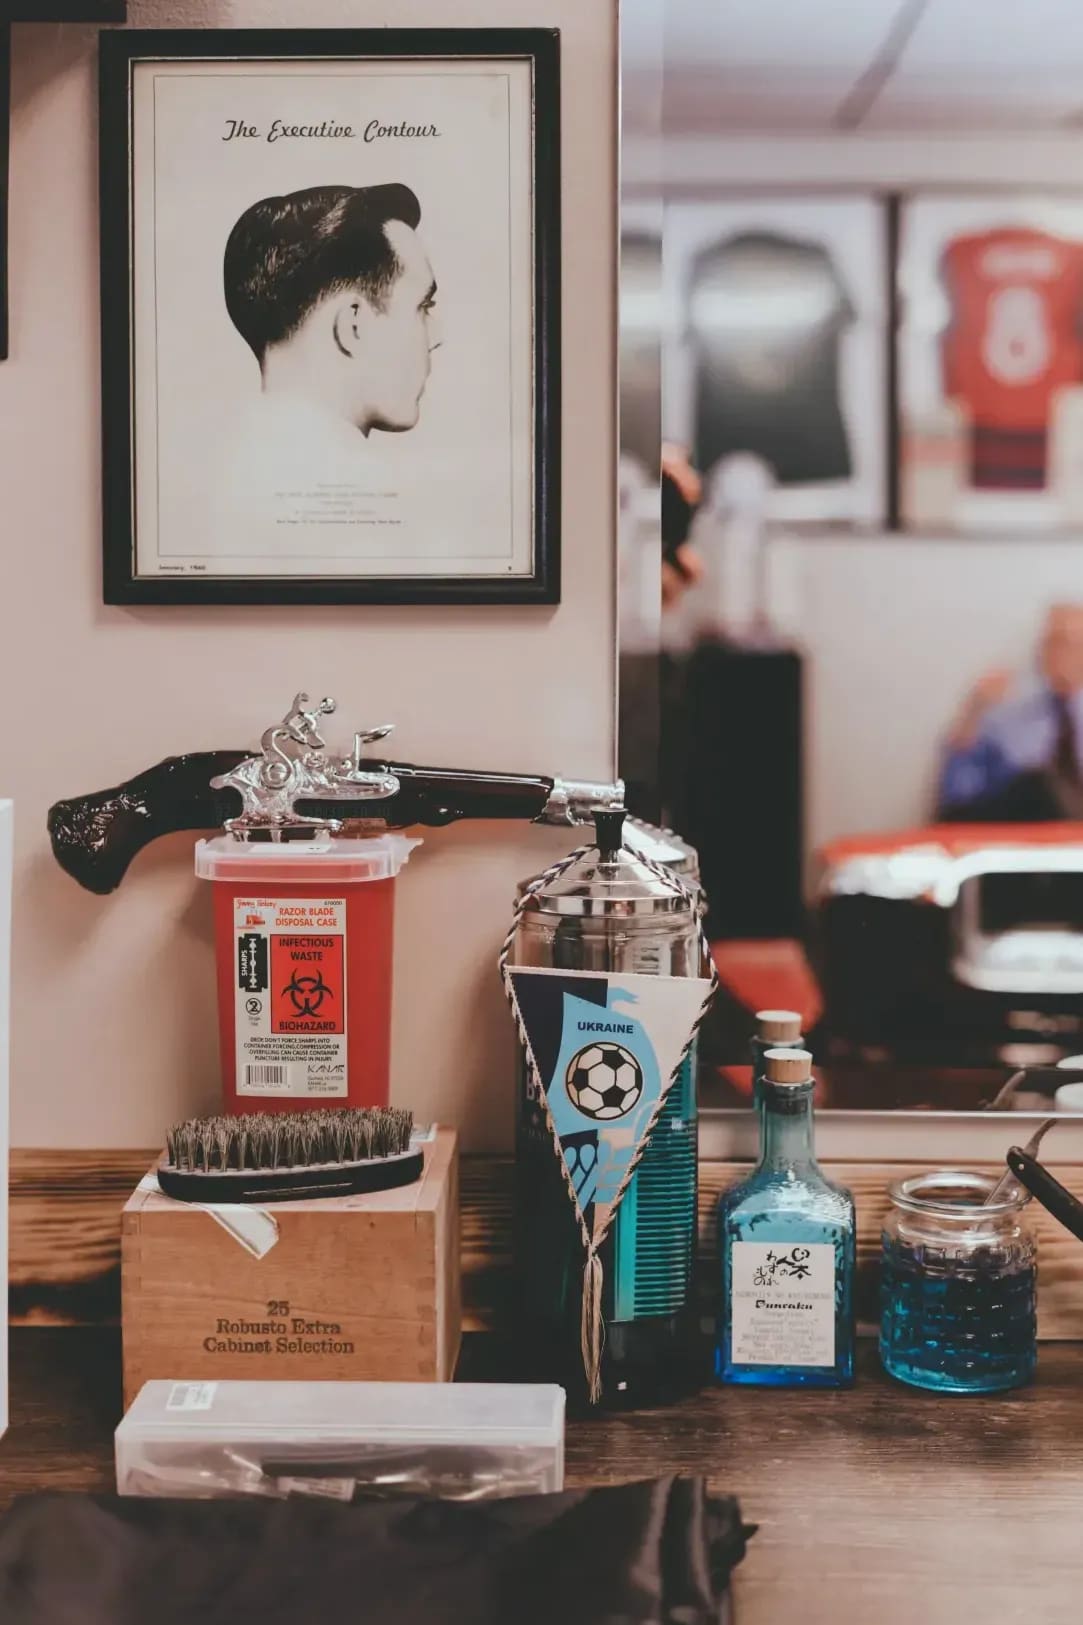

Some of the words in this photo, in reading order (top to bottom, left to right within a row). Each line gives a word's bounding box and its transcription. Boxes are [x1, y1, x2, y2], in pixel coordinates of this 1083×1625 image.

[222, 120, 261, 141] The
[267, 120, 356, 143] Executive
[363, 120, 442, 143] Contour
[279, 907, 307, 916] RAZOR
[309, 907, 334, 916] BLADE
[275, 918, 314, 926] DISPOSAL
[317, 918, 337, 926] CASE
[279, 938, 334, 948] INFECTIOUS
[290, 951, 323, 961] WASTE
[279, 1021, 336, 1031] BIOHAZARD
[577, 1021, 634, 1034] UKRAINE
[267, 1300, 290, 1316] 25
[216, 1319, 287, 1334] Robusto
[291, 1319, 341, 1335] Extra
[203, 1337, 272, 1354] Cabinet
[276, 1337, 354, 1354] Selection
